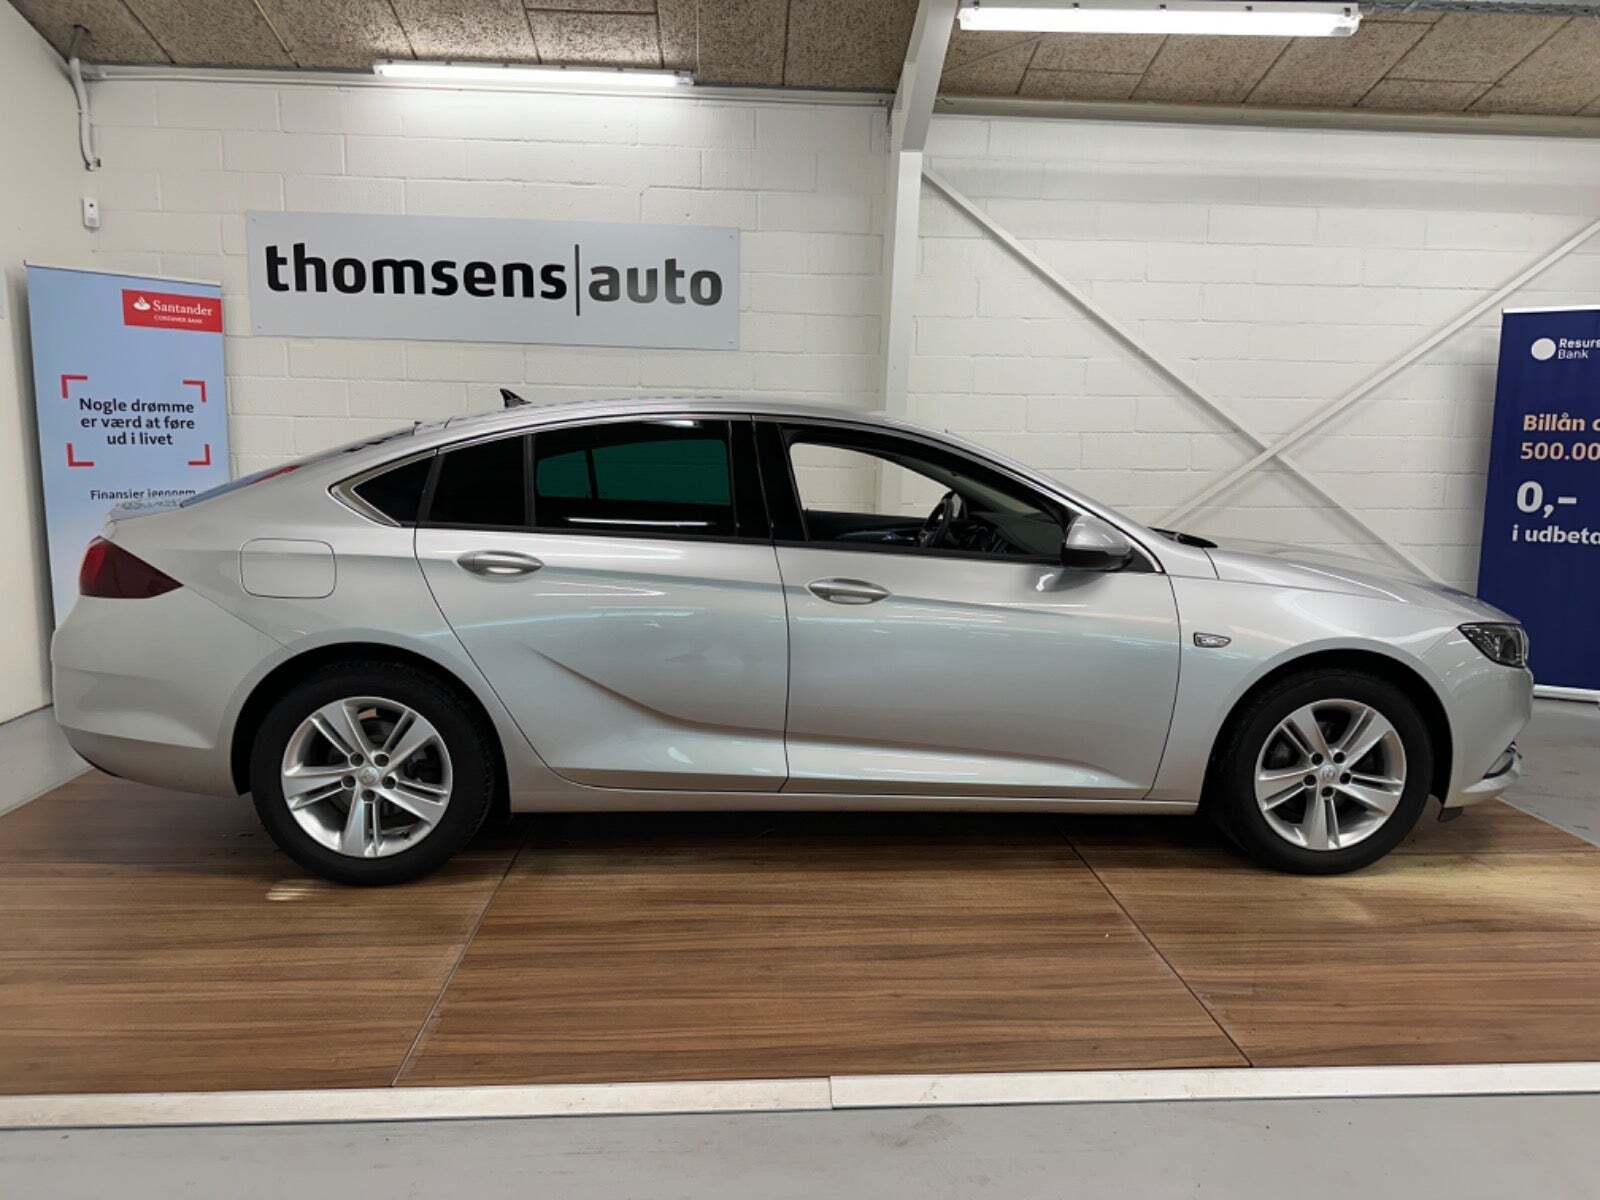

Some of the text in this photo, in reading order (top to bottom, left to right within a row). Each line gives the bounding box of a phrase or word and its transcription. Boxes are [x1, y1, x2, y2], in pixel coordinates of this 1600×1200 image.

[265, 242, 724, 306] thomsens auto
[152, 299, 213, 317] Santander
[1559, 337, 1600, 348] Resurs
[1557, 348, 1589, 360] Bank
[79, 398, 195, 415] Nogle drømme
[80, 415, 196, 430] er værd at føre
[1523, 412, 1586, 432] Billån
[107, 432, 174, 446] ud i livet
[90, 489, 145, 500] Finansier
[1511, 523, 1519, 542] i
